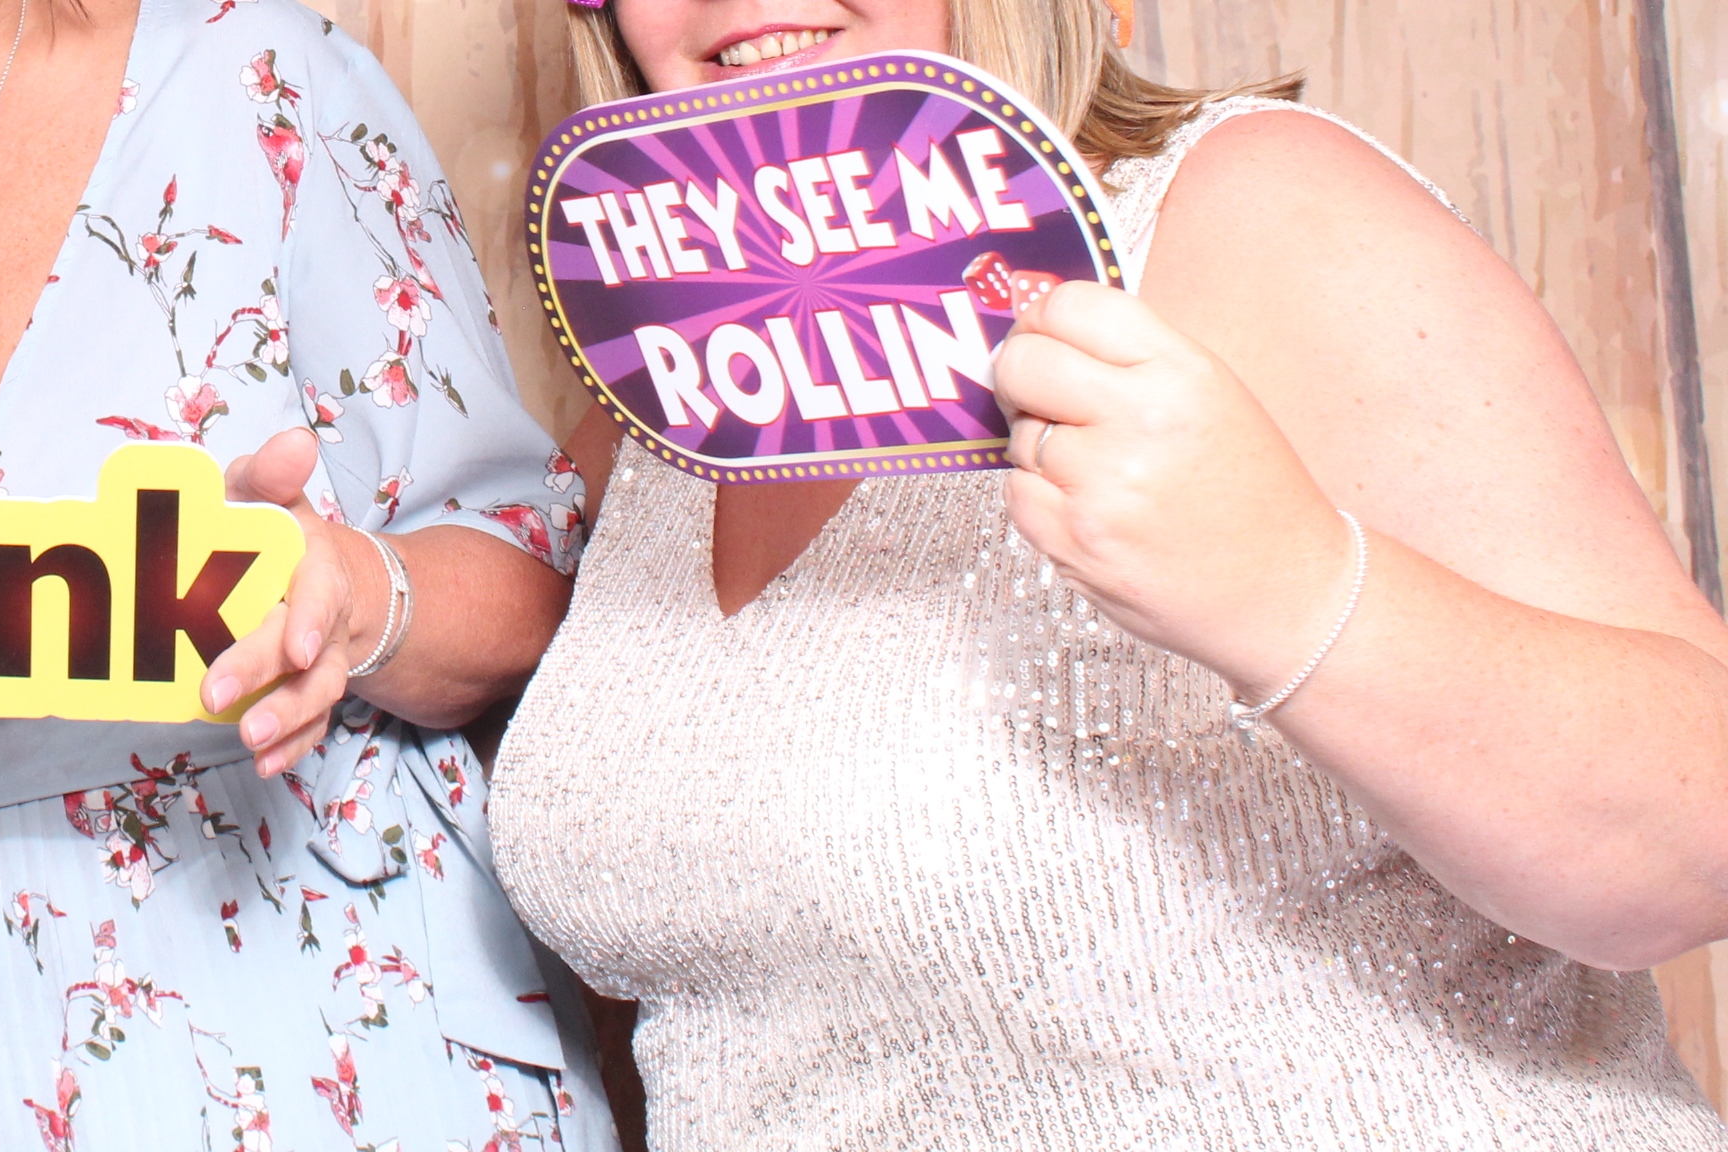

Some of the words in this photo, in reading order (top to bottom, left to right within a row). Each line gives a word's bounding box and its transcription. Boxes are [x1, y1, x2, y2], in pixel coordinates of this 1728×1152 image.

[559, 175, 747, 287] THEY
[753, 149, 899, 267] SEE
[893, 126, 1035, 241] ME
[633, 288, 996, 432] ROLLIN
